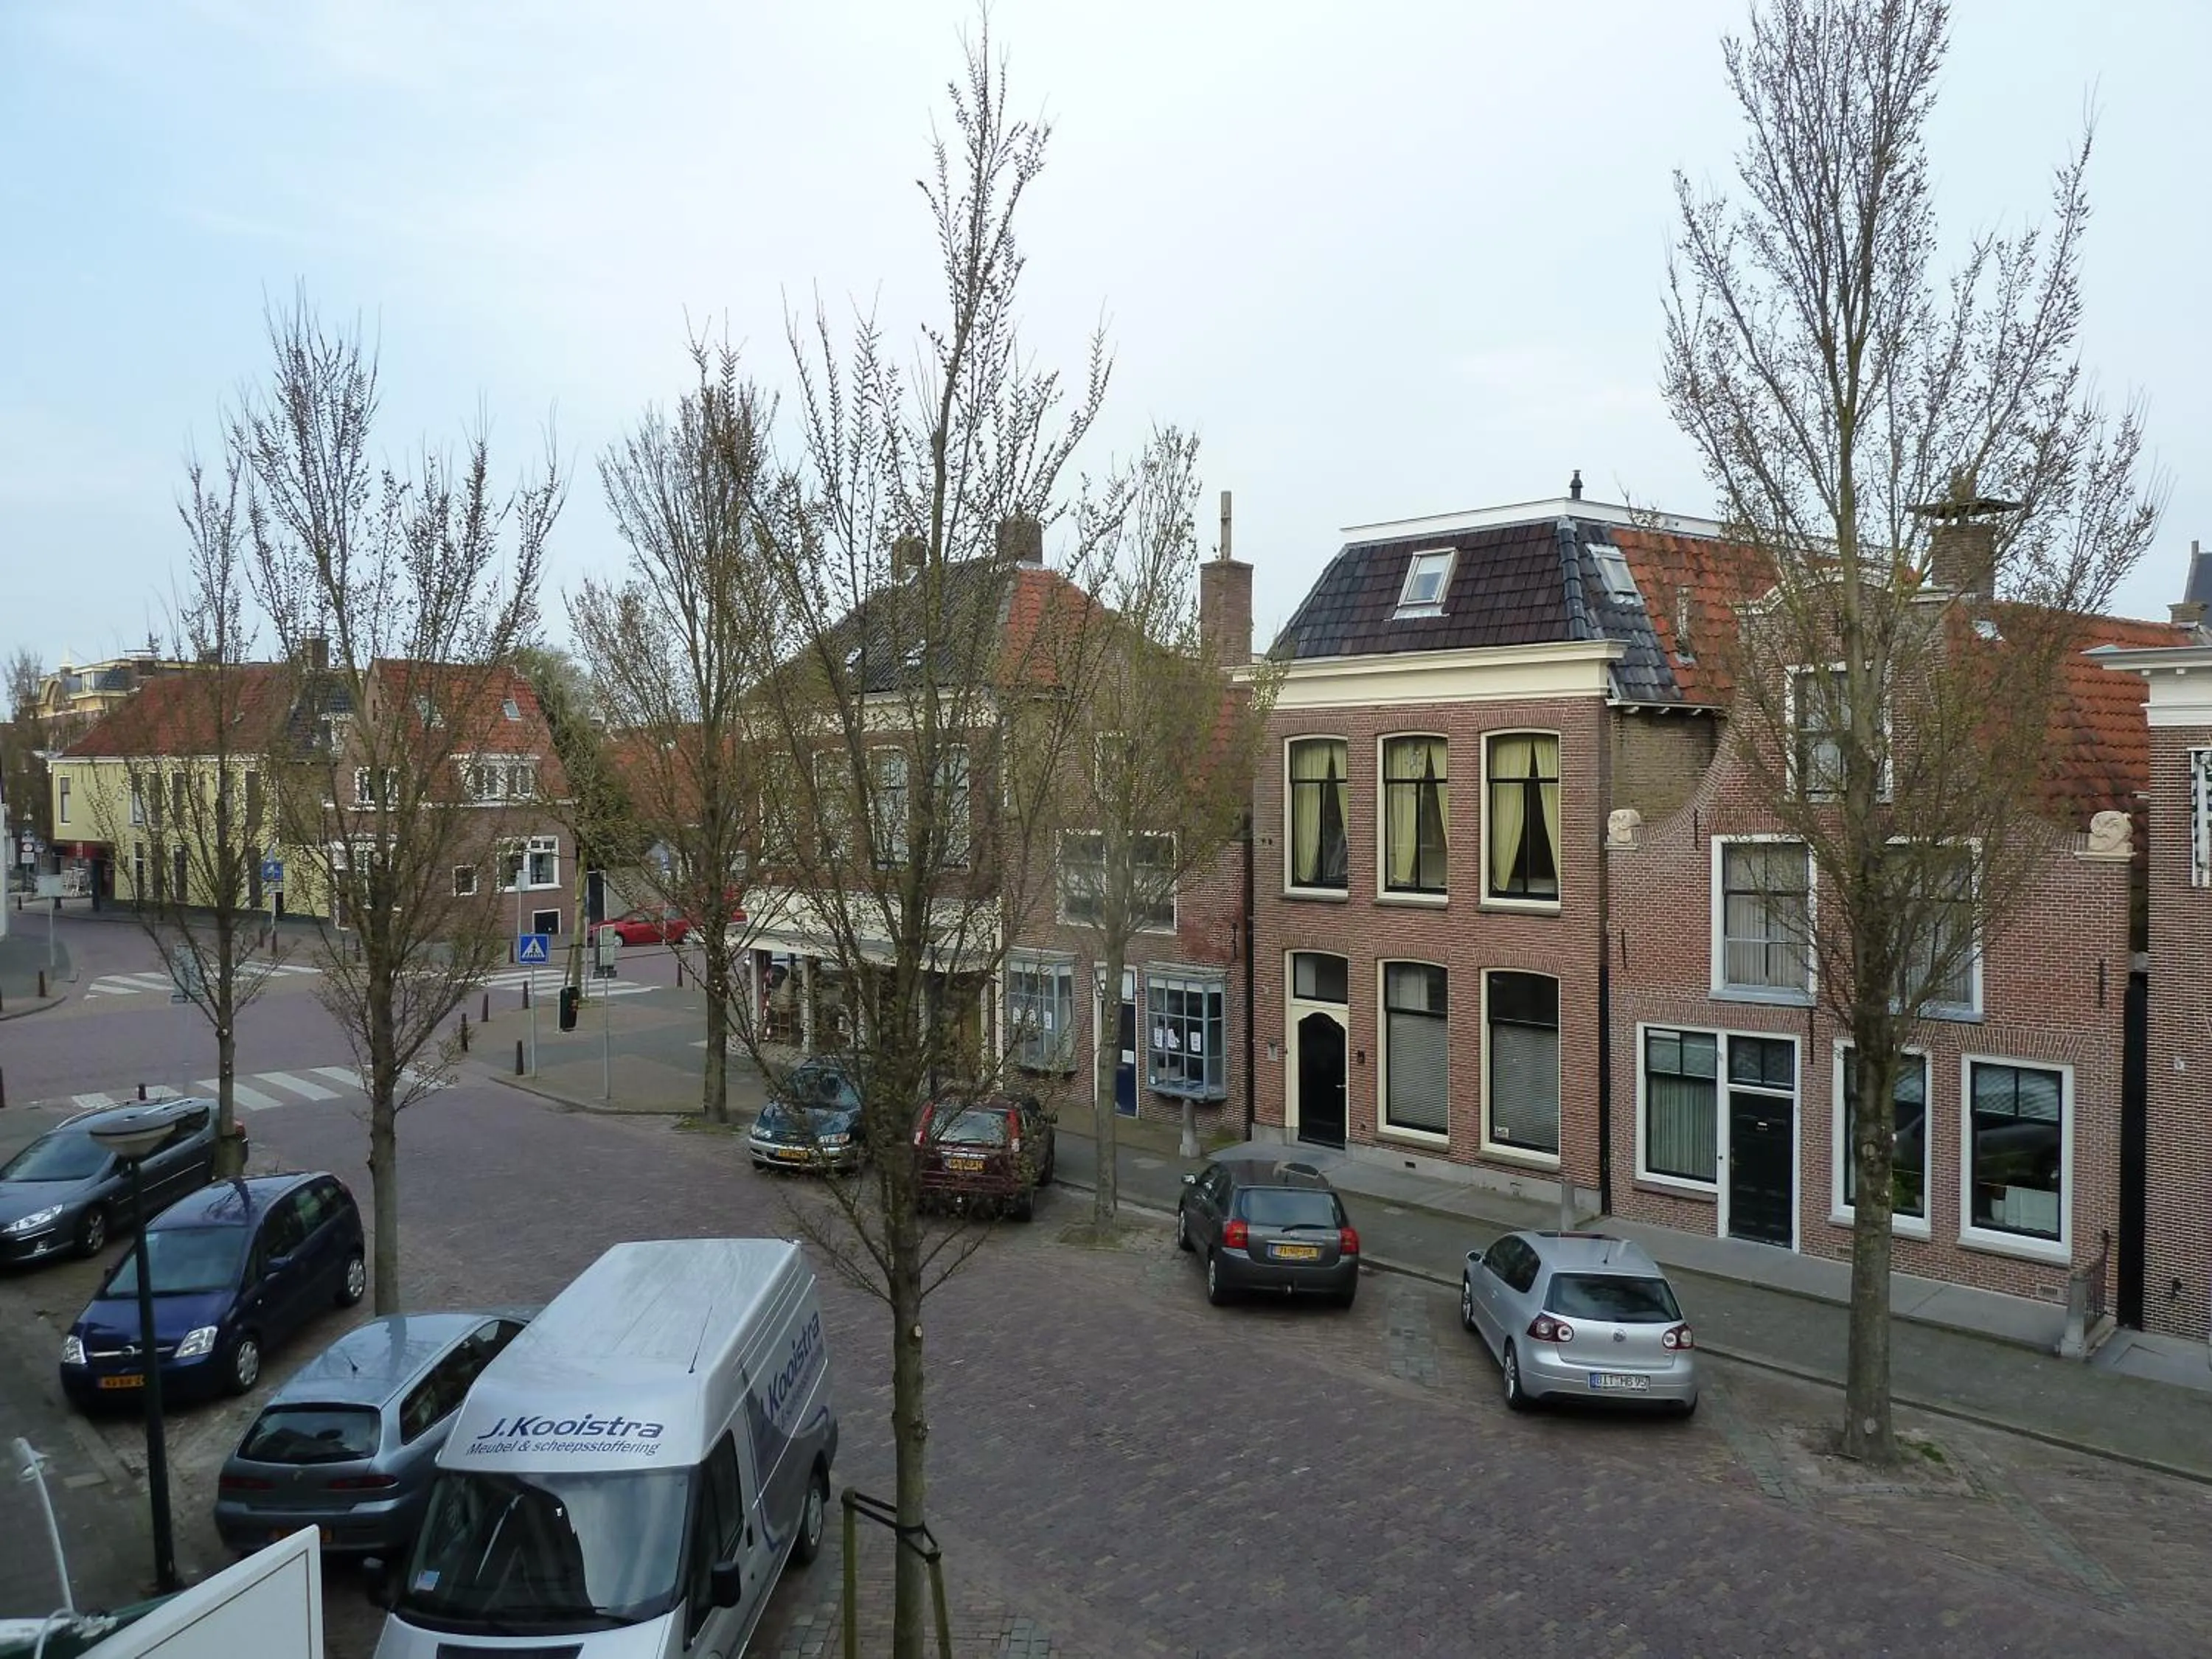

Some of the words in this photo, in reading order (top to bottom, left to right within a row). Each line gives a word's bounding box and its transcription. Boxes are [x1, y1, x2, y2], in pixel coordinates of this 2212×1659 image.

[467, 1441, 517, 1455] Meubel
[518, 1440, 529, 1453] &
[534, 1440, 661, 1455] scheepsstoffering
